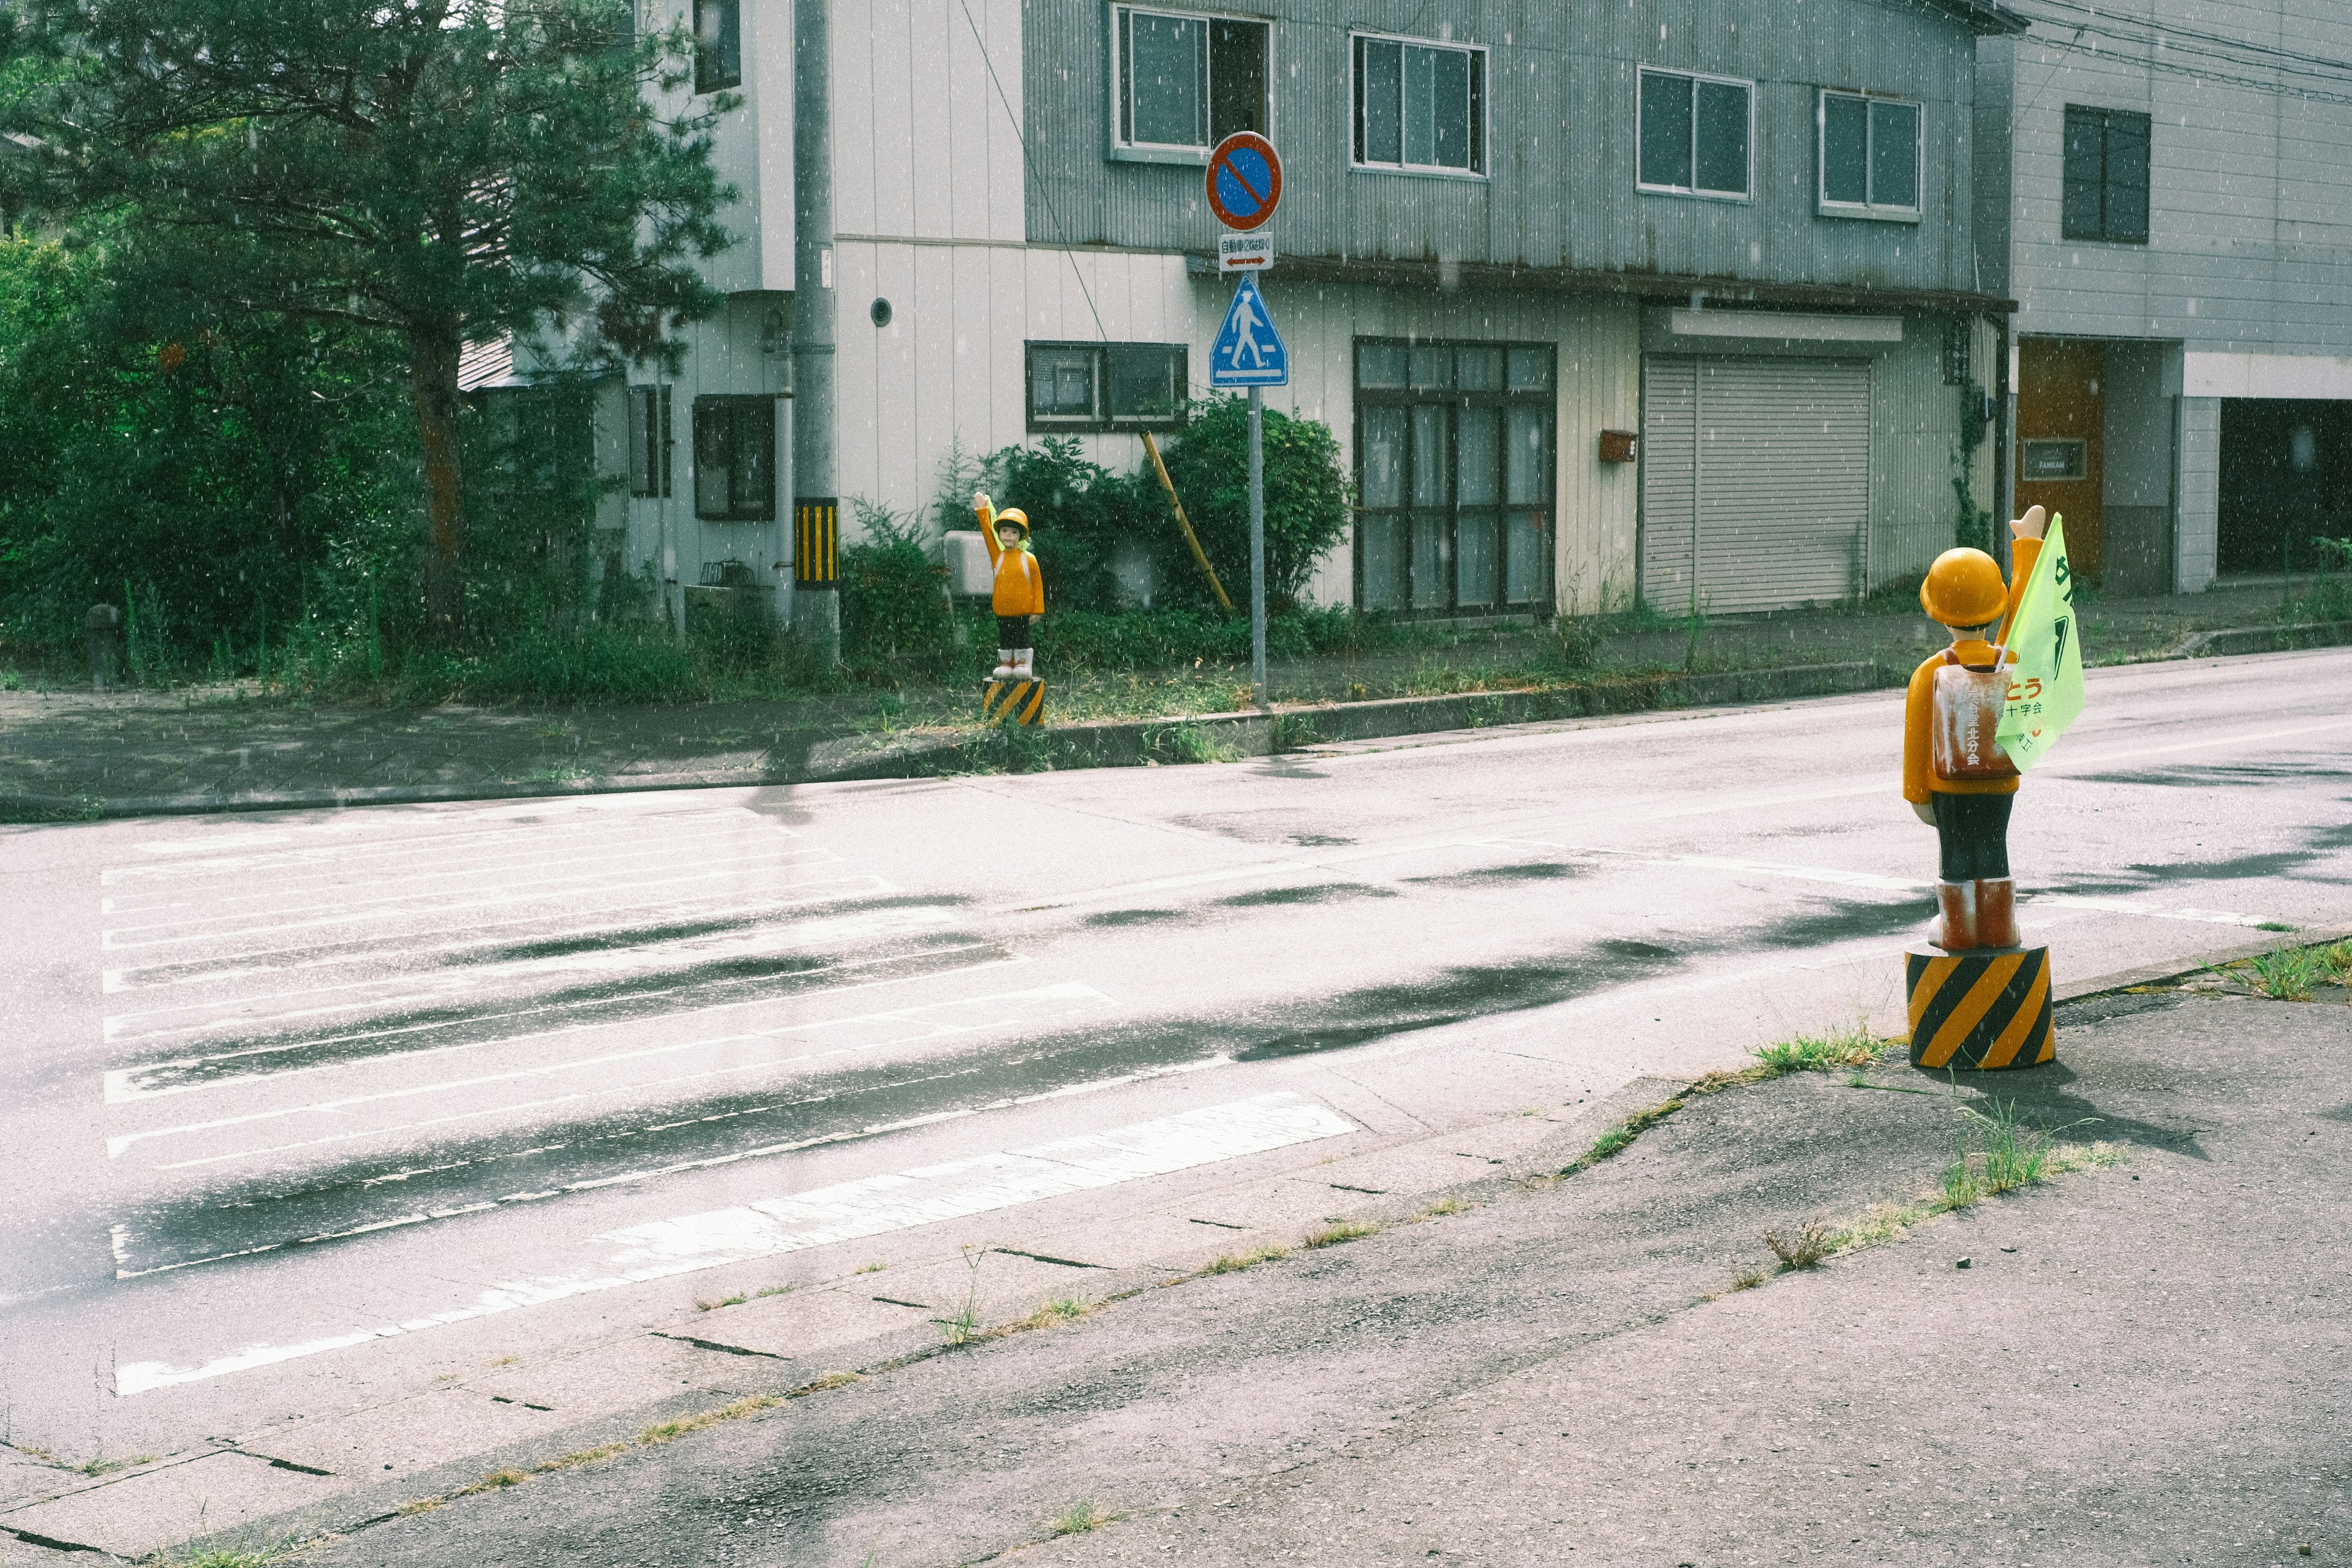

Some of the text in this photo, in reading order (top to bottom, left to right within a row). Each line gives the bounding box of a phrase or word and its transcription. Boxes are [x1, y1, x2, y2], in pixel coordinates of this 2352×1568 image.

[2006, 678, 2041, 701] とう
[2003, 702, 2042, 717] 十字会
